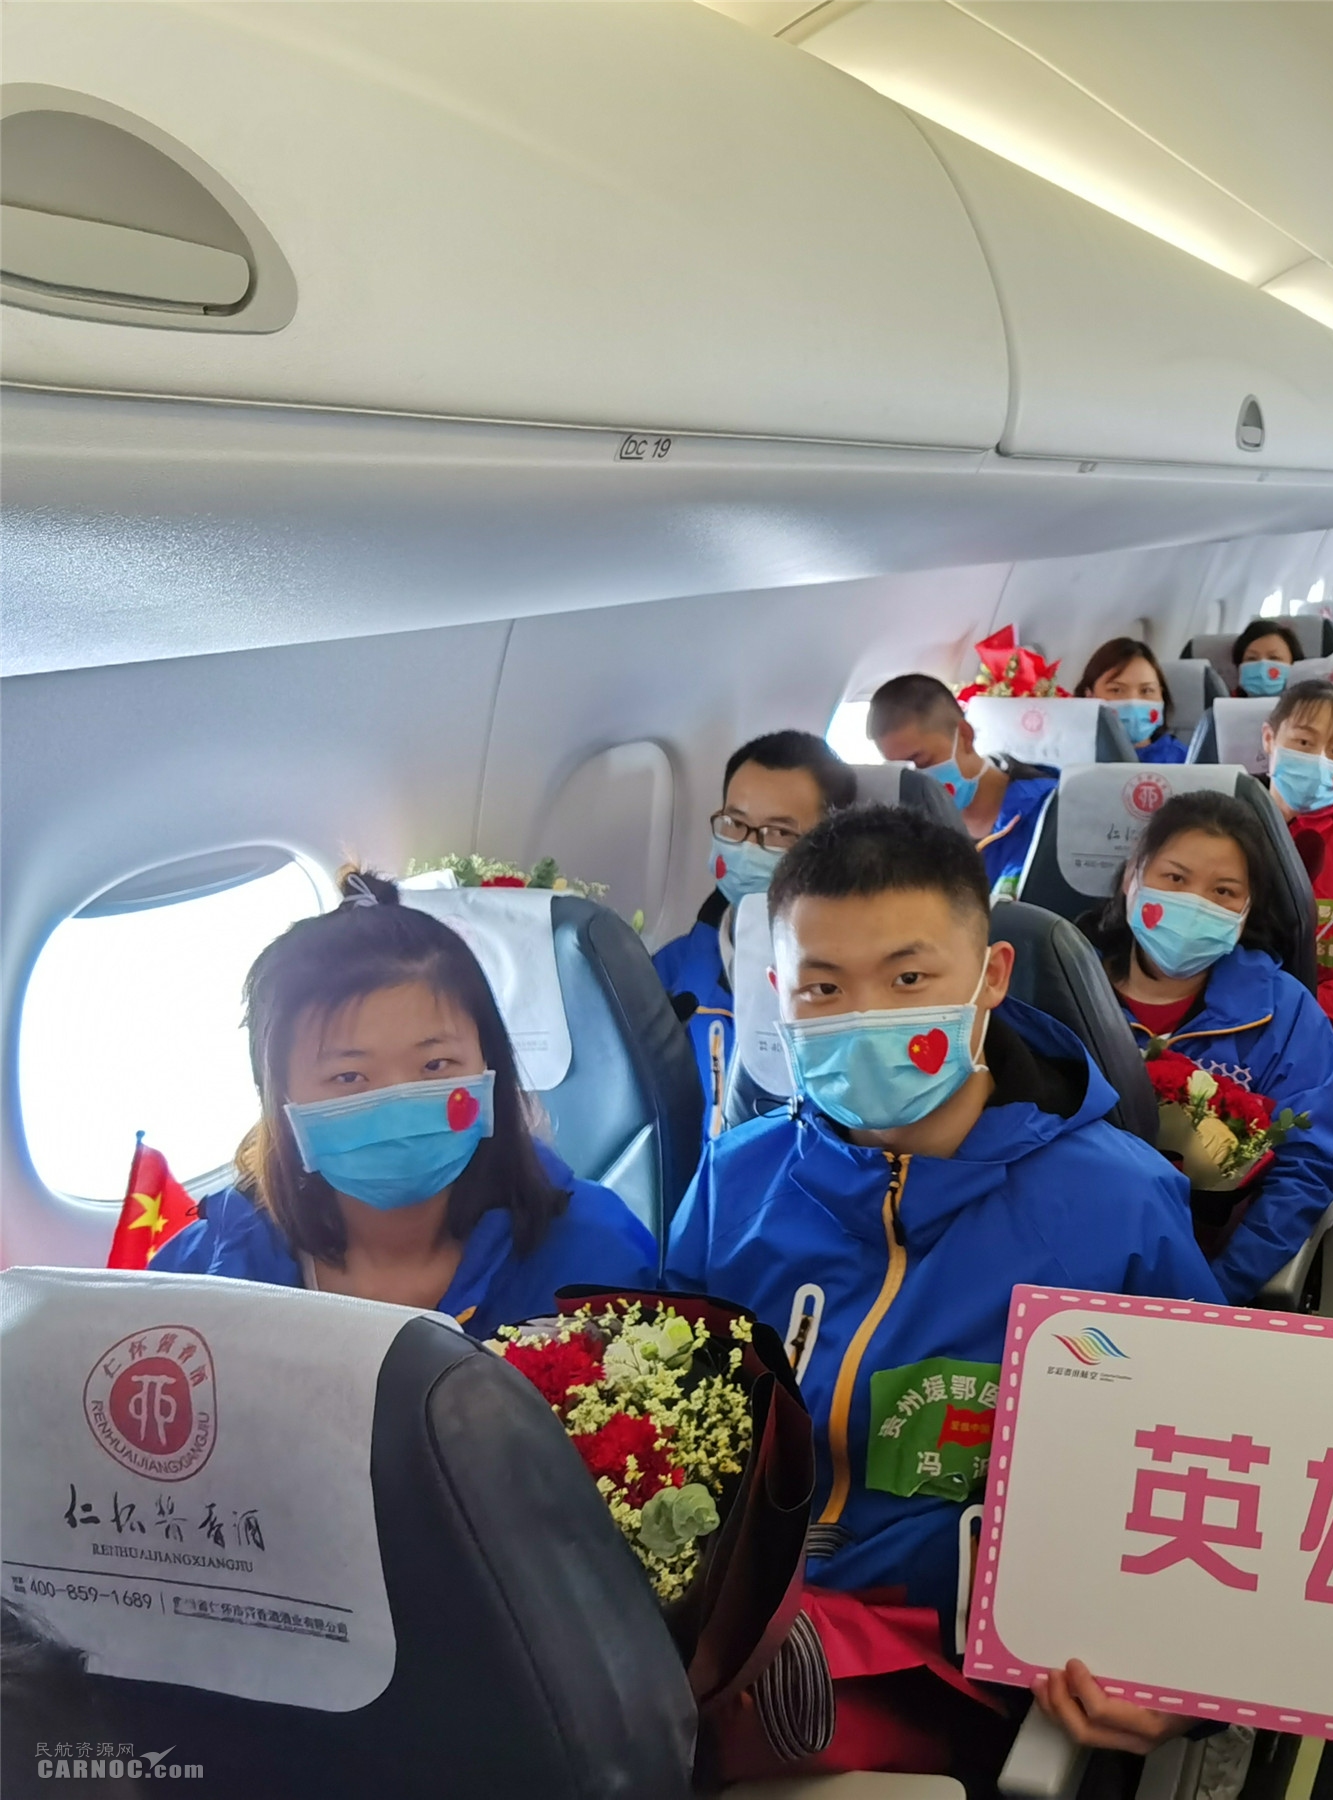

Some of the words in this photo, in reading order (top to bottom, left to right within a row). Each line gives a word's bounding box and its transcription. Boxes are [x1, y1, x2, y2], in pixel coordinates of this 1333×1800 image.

[624, 439, 648, 456] DC
[652, 438, 672, 458] 19
[30, 1579, 153, 1610] 400-859-1689
